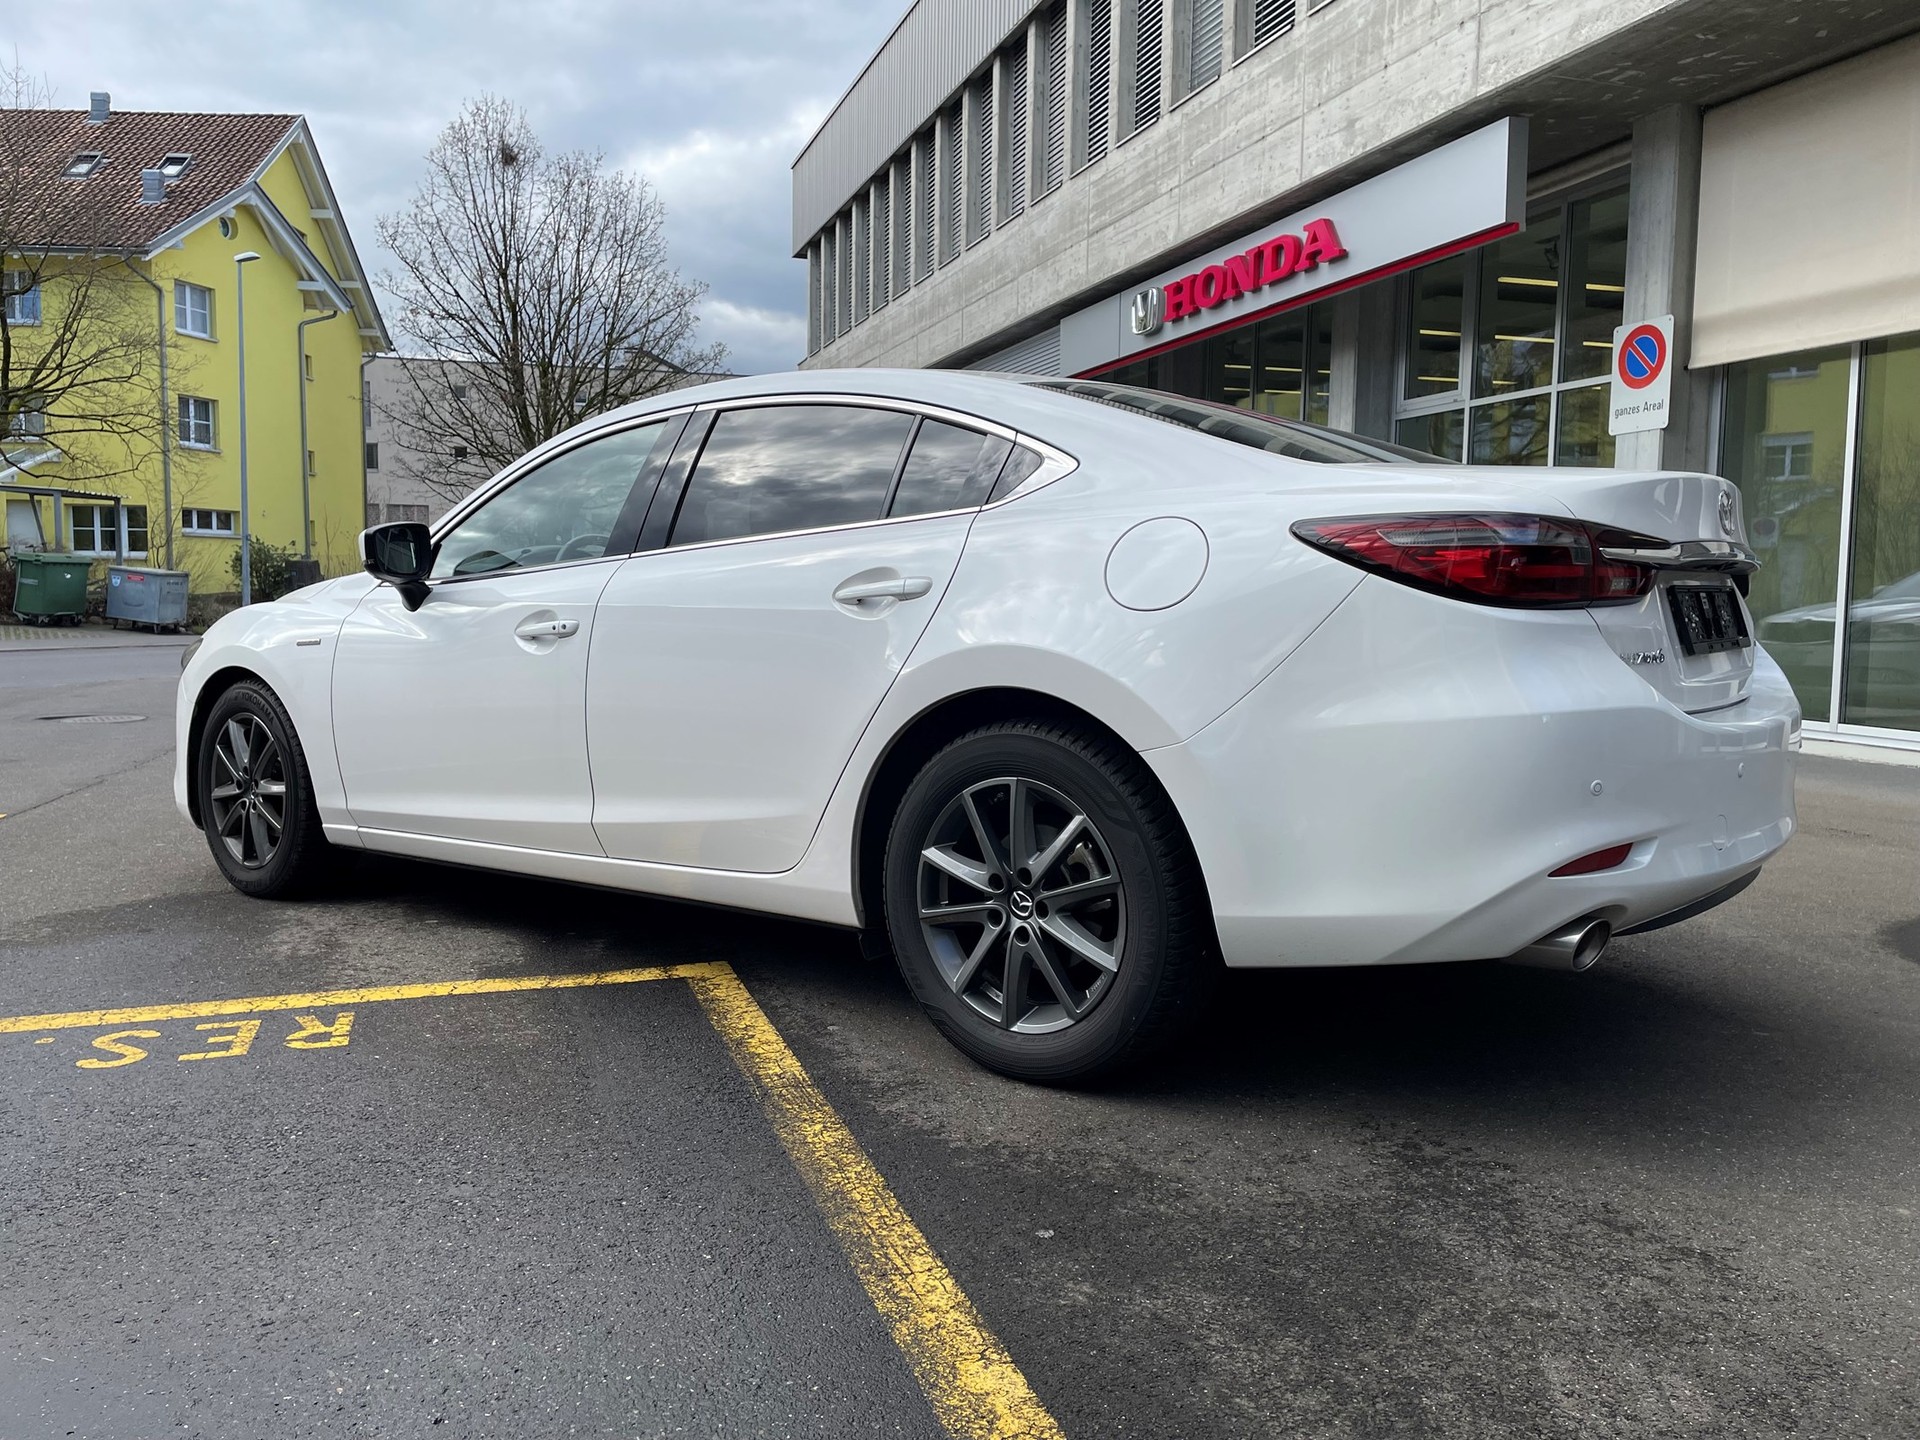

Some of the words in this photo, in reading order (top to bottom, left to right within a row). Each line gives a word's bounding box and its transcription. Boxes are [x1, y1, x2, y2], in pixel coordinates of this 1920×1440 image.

[1163, 217, 1348, 323] HONDA
[1614, 406, 1640, 419] ganzes
[1643, 399, 1664, 412] Areal
[241, 690, 275, 727] YOKOHAMA
[1134, 863, 1160, 987] YOKOHAMA
